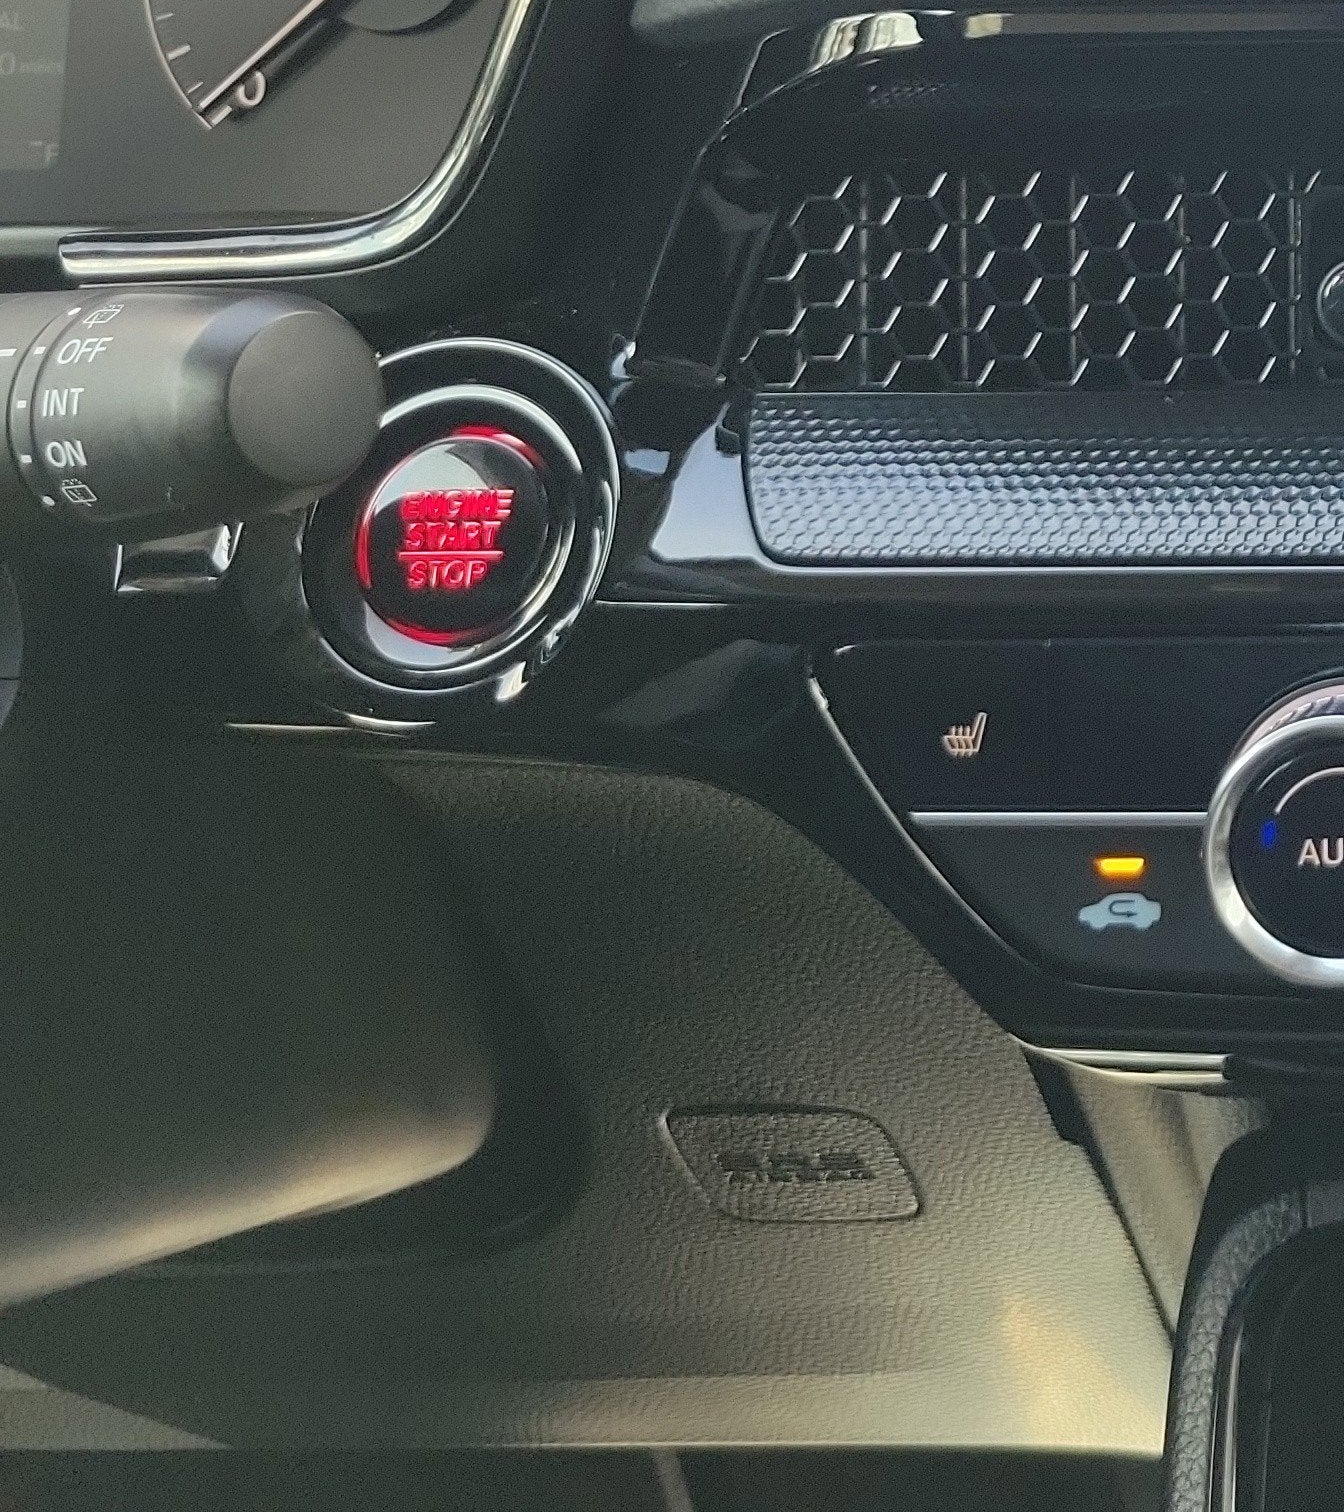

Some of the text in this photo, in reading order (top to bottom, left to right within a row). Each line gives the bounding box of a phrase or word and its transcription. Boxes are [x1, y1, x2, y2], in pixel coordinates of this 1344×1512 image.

[236, 70, 267, 107] 0
[57, 337, 114, 365] OFF
[42, 388, 84, 417] INT
[46, 440, 87, 467] ON
[402, 489, 514, 519] ENGINE
[405, 520, 501, 550] START
[408, 560, 488, 588] STOP
